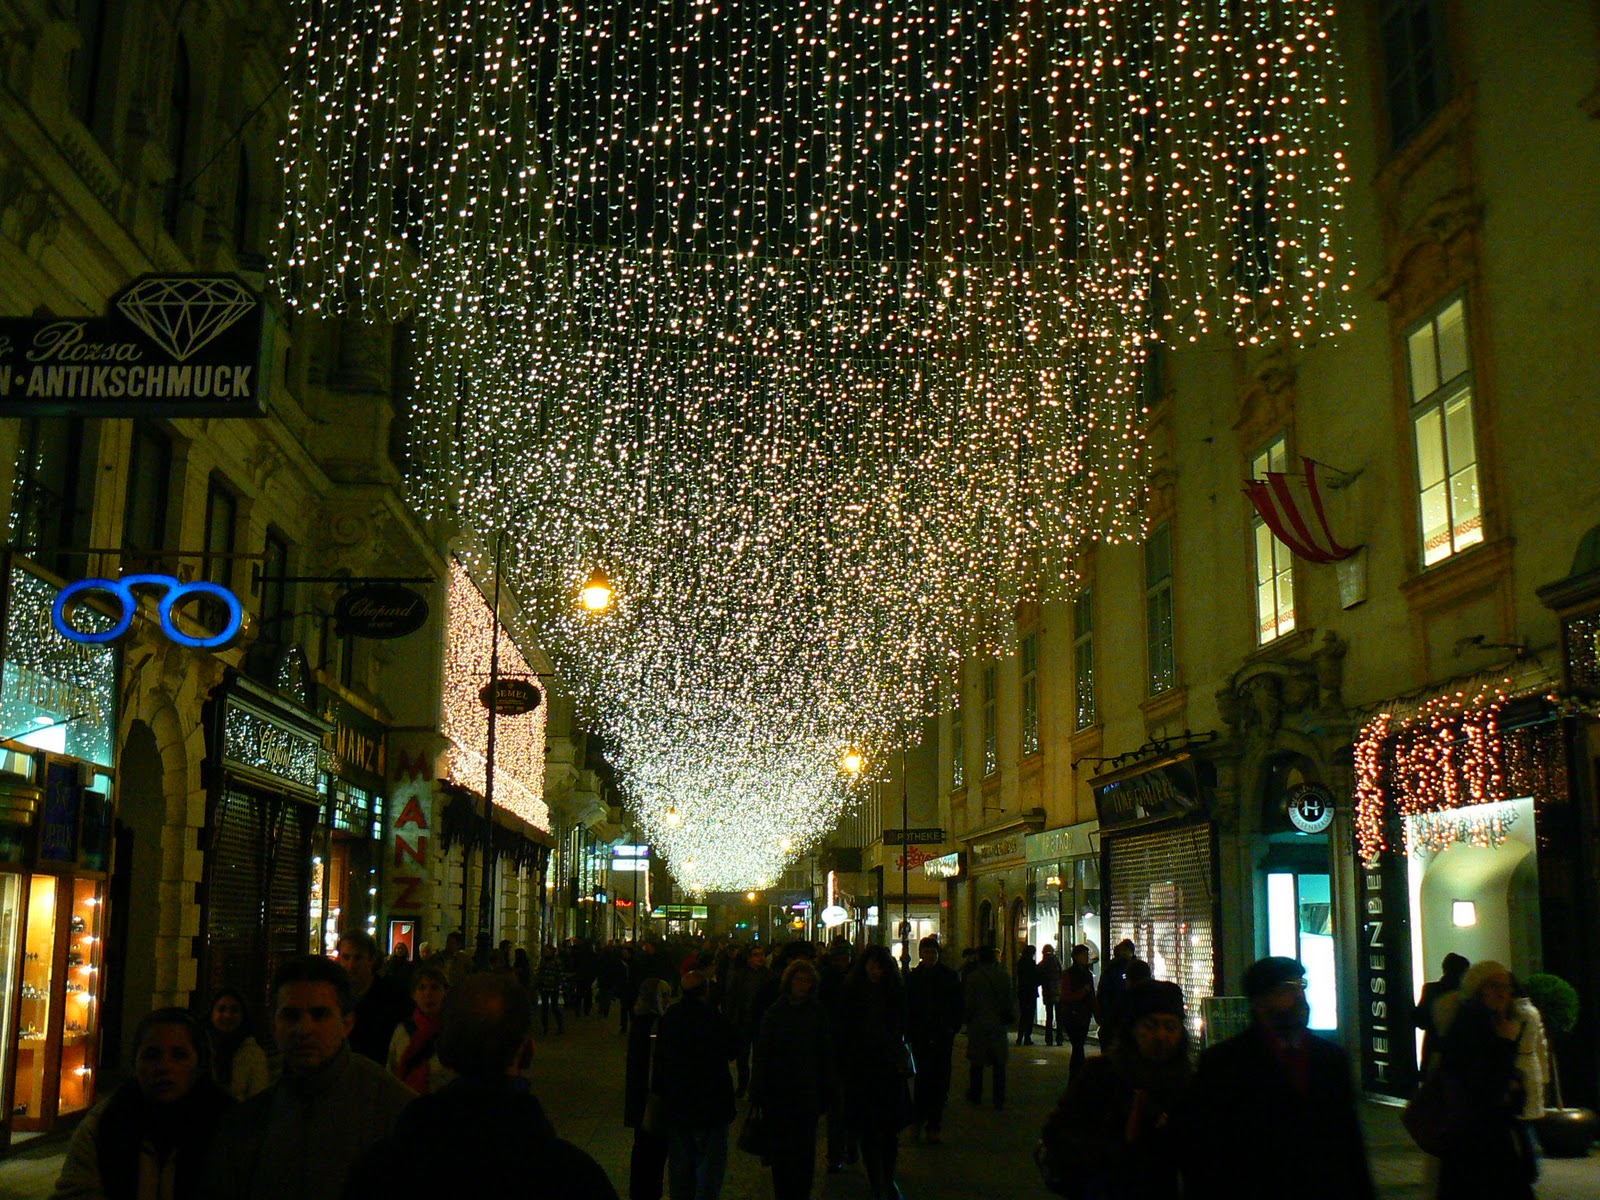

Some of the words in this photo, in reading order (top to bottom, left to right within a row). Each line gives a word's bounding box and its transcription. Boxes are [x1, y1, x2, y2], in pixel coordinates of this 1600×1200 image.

[26, 321, 143, 361] Rozsa
[26, 364, 252, 398] ANTIKSCHMUCK
[336, 720, 375, 772] MANZ
[394, 750, 430, 909] MANZ
